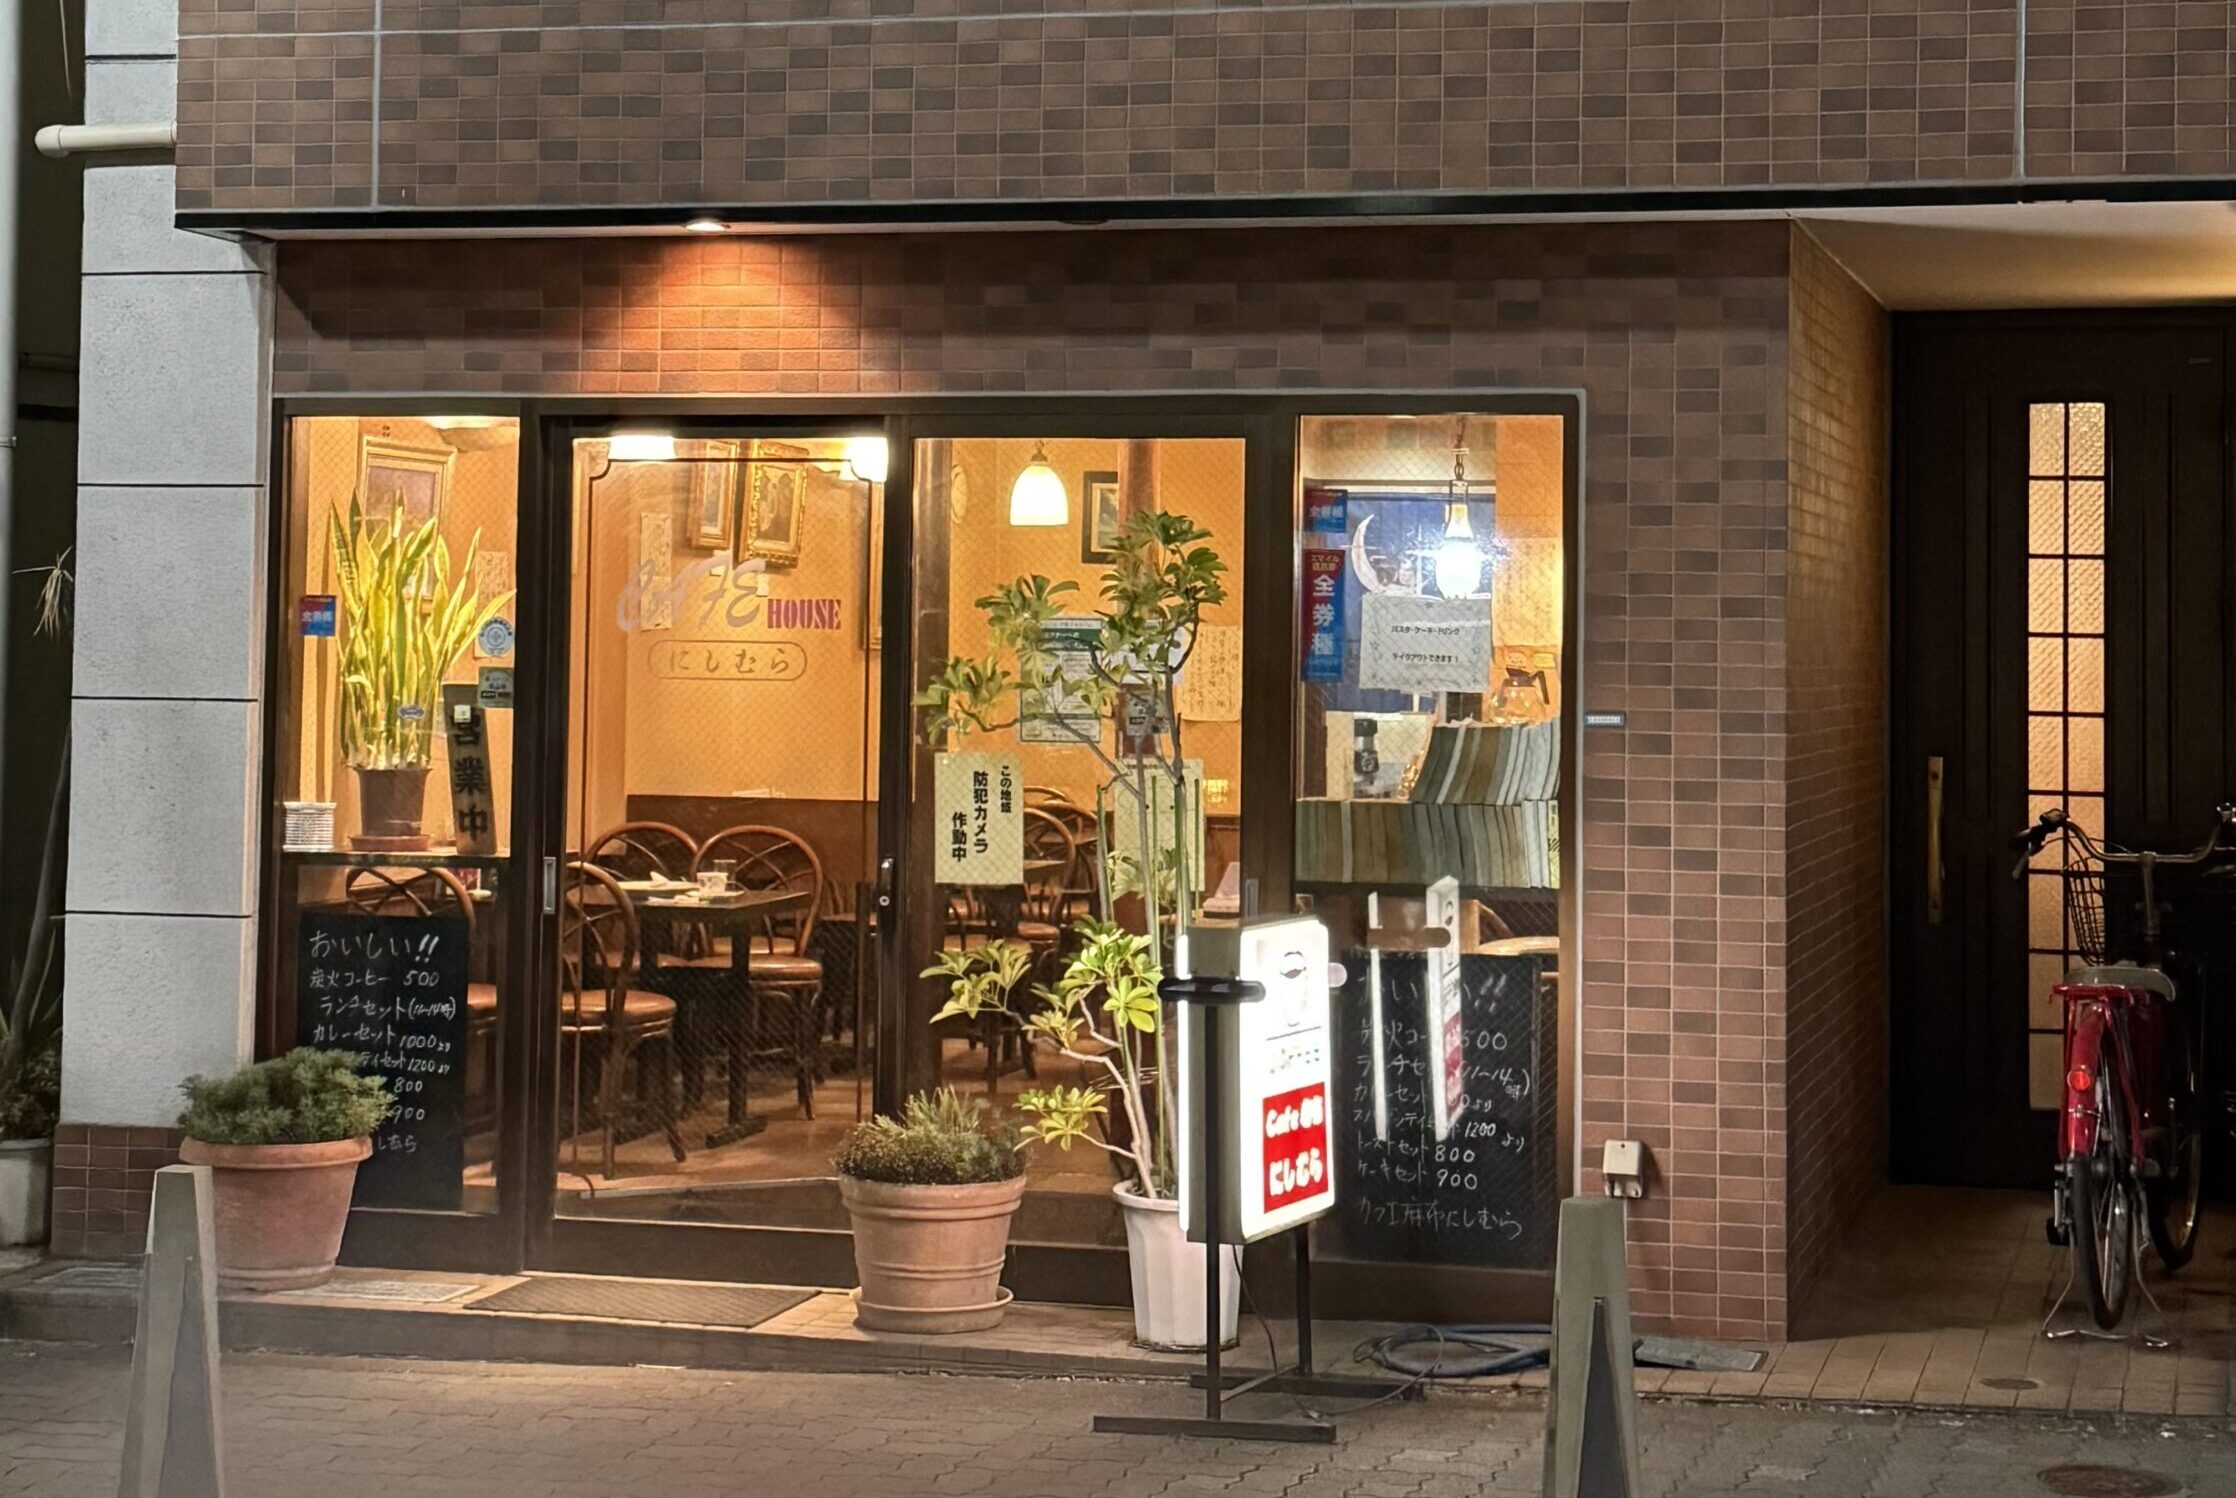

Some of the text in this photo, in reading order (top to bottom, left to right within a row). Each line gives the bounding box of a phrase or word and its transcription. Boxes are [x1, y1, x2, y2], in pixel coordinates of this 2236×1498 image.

[767, 598, 842, 630] HOUSE
[670, 648, 790, 674] にしむら
[973, 770, 989, 854] 防犯カメラ
[952, 811, 967, 862] 作動中
[309, 966, 440, 990] 炭火コーヒー 500
[313, 1023, 396, 1046] カレーセット
[394, 1077, 424, 1094] 800
[392, 1105, 426, 1125] 900
[1464, 1121, 1497, 1138] 1200
[378, 1134, 417, 1154] しむら
[1358, 1129, 1476, 1164] トーストセット 800
[1269, 1147, 1324, 1197] にしむら
[1357, 1158, 1478, 1191] ケーキセット 900
